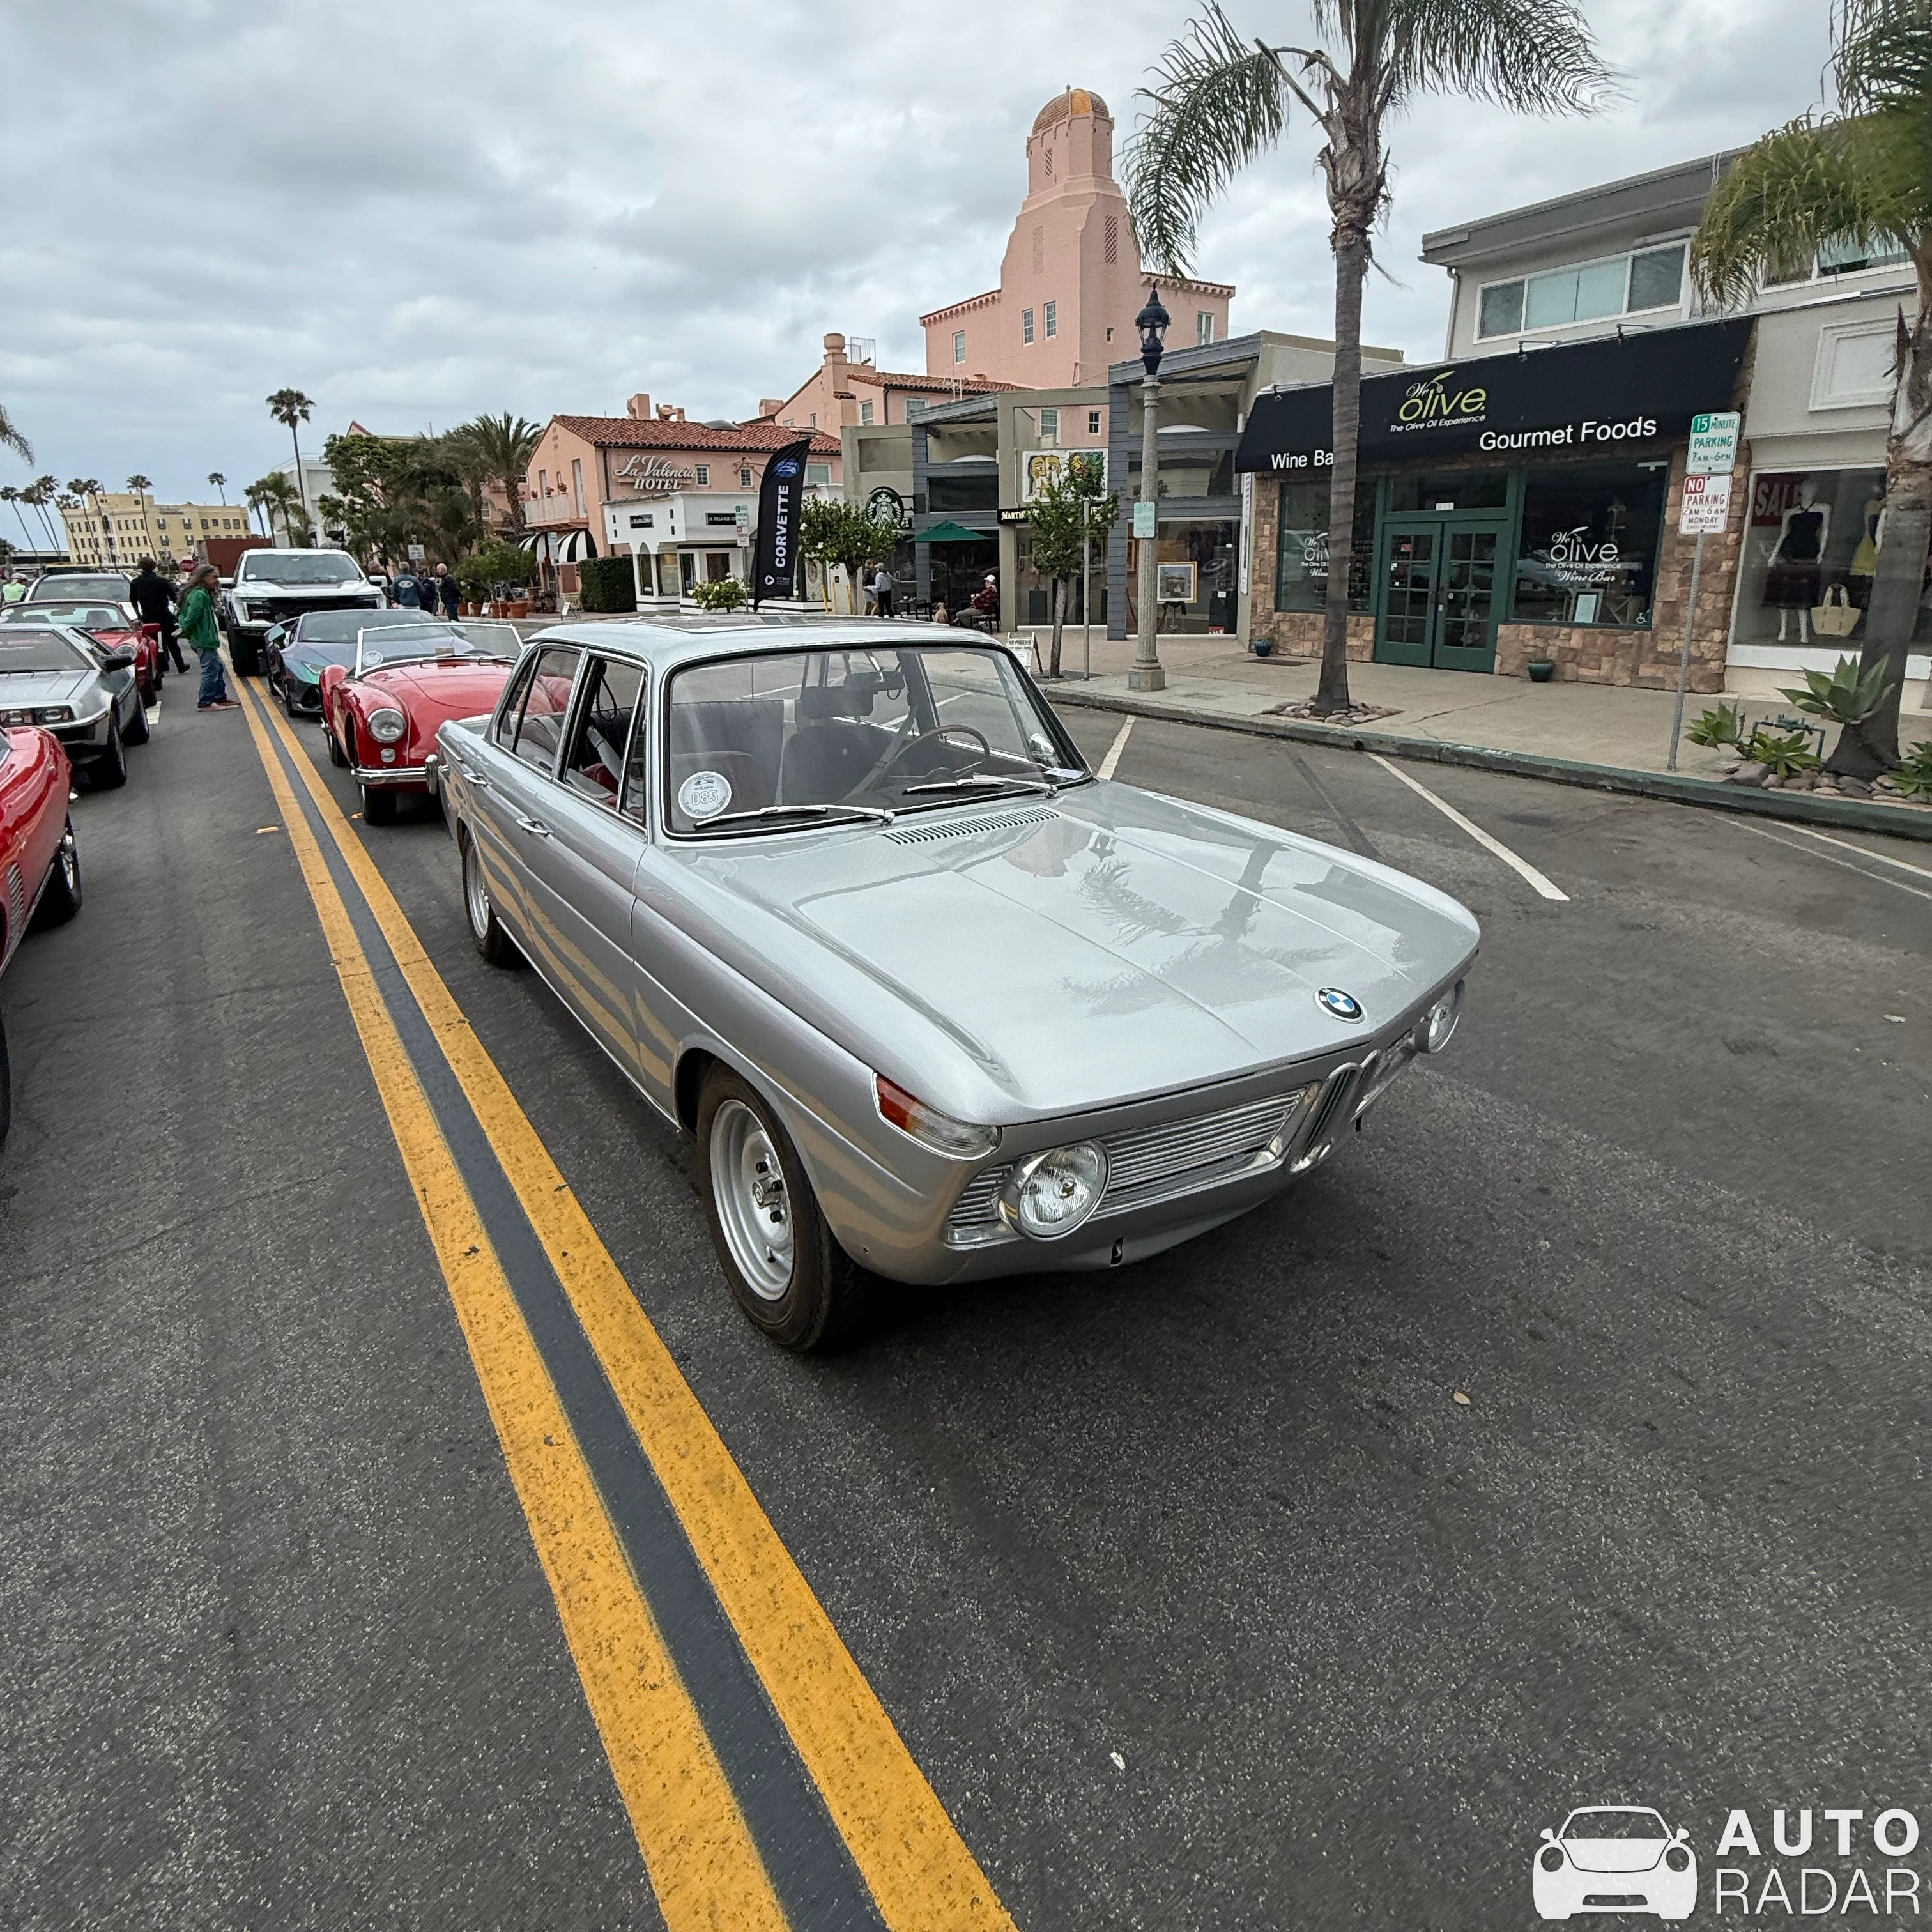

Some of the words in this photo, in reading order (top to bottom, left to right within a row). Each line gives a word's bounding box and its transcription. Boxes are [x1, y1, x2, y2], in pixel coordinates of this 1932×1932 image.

[1406, 382, 1429, 398] We
[1406, 422, 1425, 431] Olive
[1427, 419, 1438, 427] Oil
[1439, 415, 1485, 427] Experience
[1696, 417, 1708, 431] 15
[1710, 419, 1737, 429] MINUTE
[1480, 424, 1574, 450] Gourmet
[1581, 416, 1657, 441] Foods
[1694, 436, 1733, 448] PARKING
[614, 455, 640, 477] La
[641, 456, 695, 478] Valencia
[1271, 452, 1307, 470] Wine
[1314, 449, 1333, 466] Ba
[634, 479, 682, 489] HOTEL
[1687, 479, 1704, 493] NO
[1687, 494, 1725, 505] PARKING
[775, 485, 789, 568] CORVETTE
[1551, 532, 1570, 544] We
[1304, 542, 1329, 561] oli
[1558, 571, 1587, 581] Wine
[1588, 570, 1616, 581] Bar
[692, 789, 718, 805] 085
